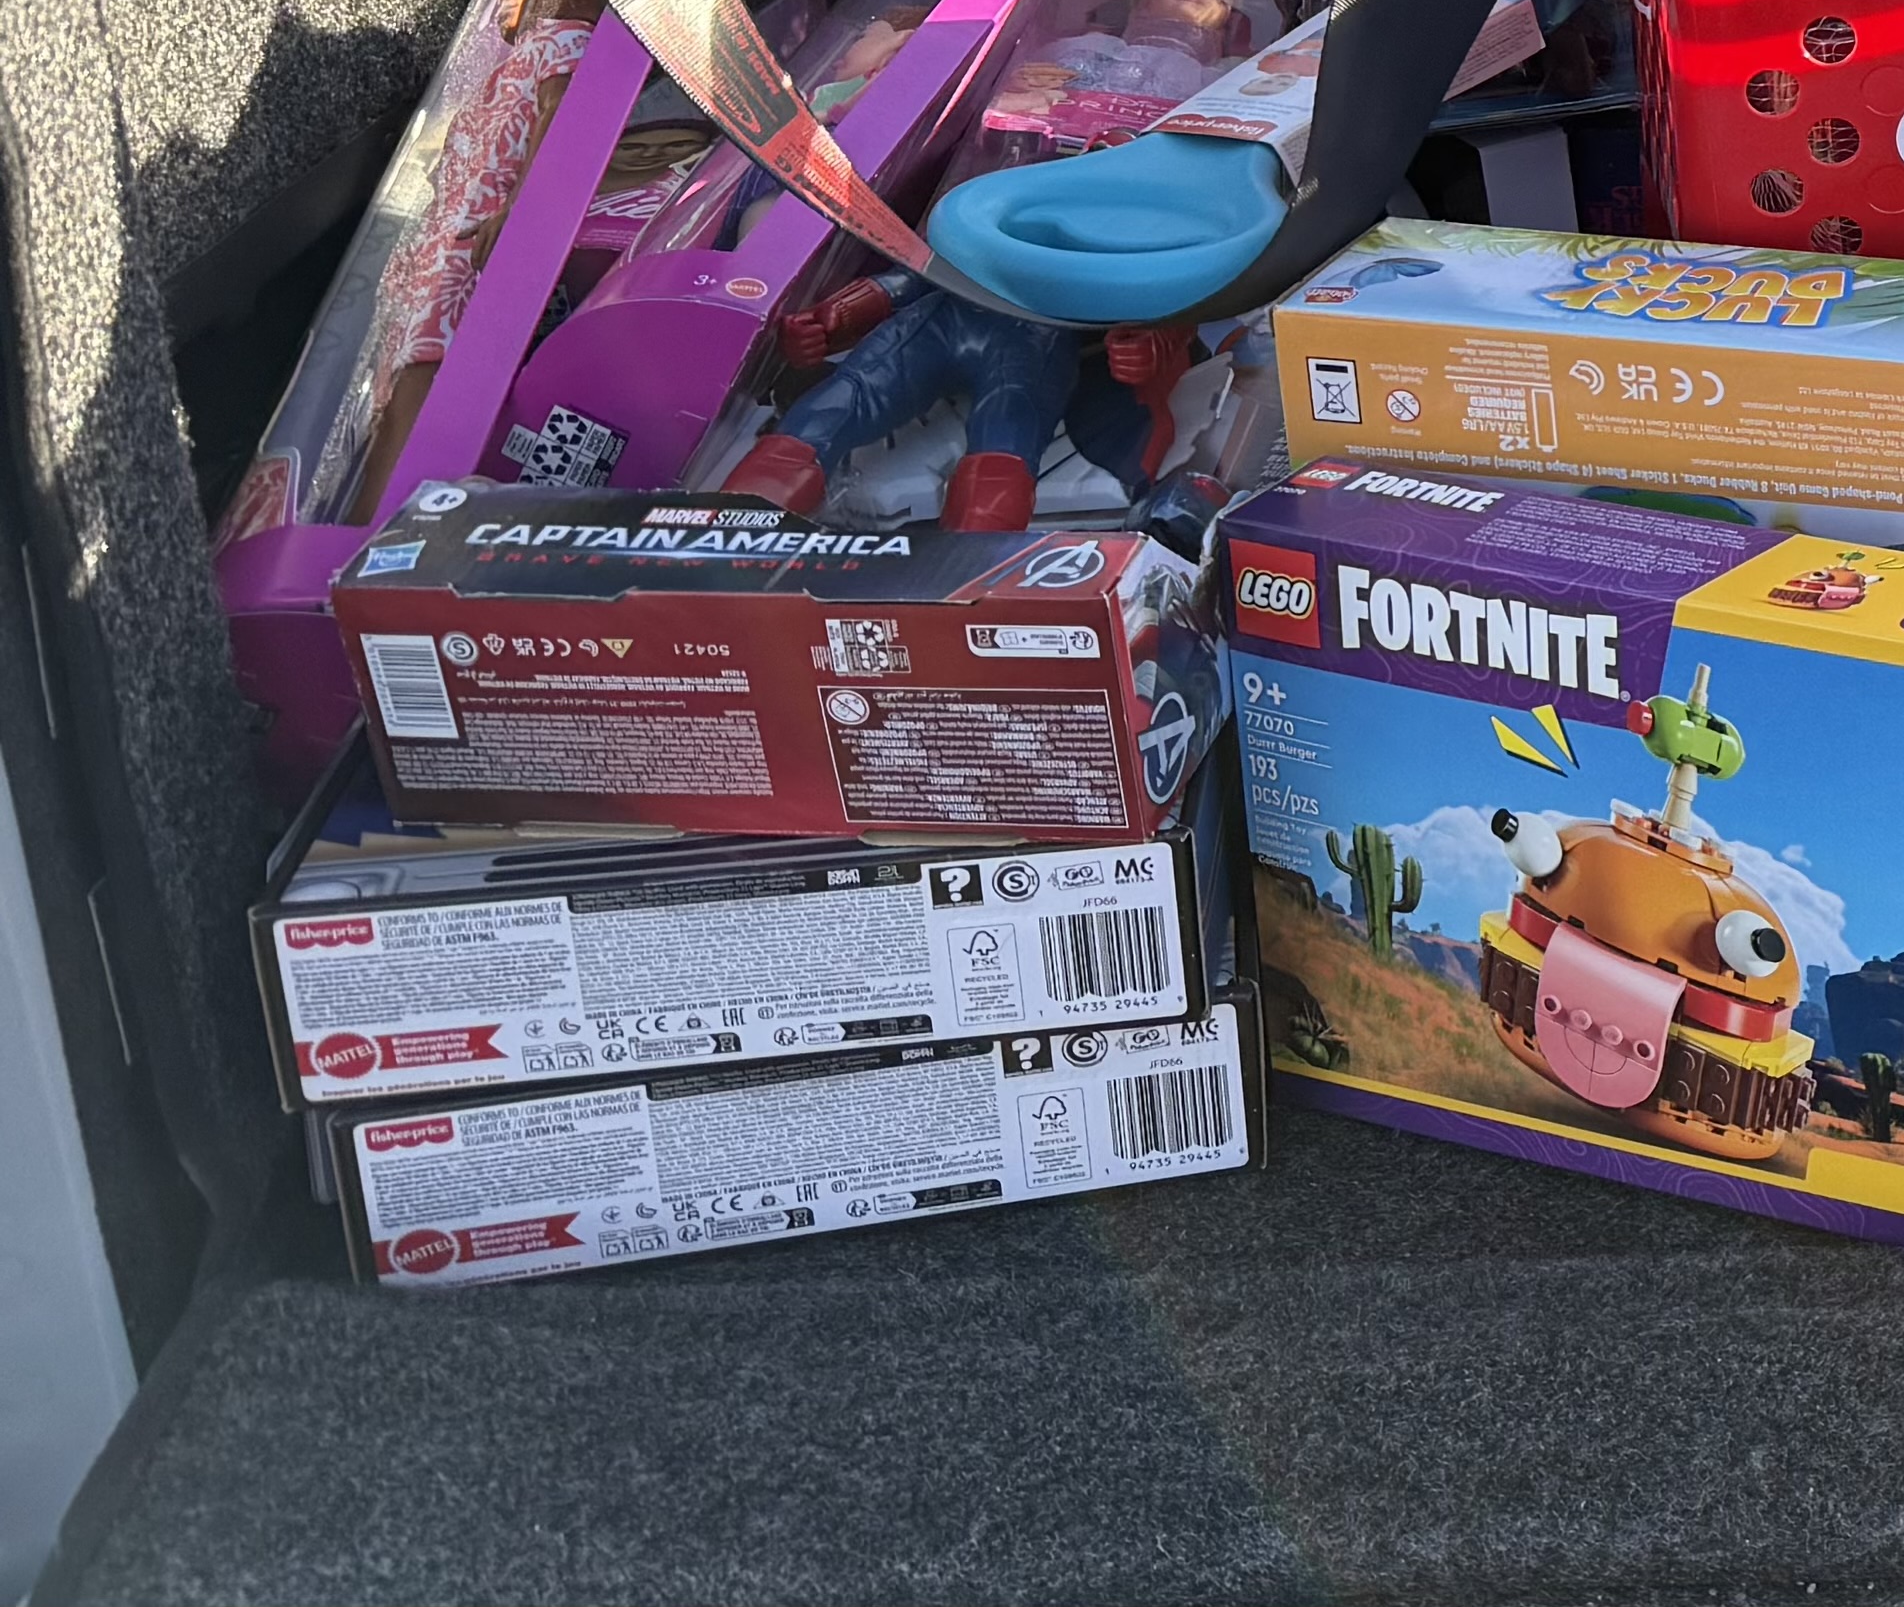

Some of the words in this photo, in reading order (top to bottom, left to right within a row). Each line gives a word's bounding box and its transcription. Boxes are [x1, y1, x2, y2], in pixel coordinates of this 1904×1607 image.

[1580, 251, 1848, 300] DUCKS
[1540, 282, 1829, 328] LUCKY
[1469, 396, 1527, 409] REQUIRED
[1466, 406, 1528, 422] BATTERIES
[1498, 435, 1531, 452] x2
[1416, 450, 1469, 466] Complete
[1470, 456, 1492, 467] and
[1493, 456, 1544, 473] Stickers)
[1546, 462, 1580, 477] Shape
[1594, 466, 1629, 481] Sheet
[1630, 469, 1670, 485] Sticker
[1302, 467, 1353, 483] LEGO
[1343, 470, 1505, 513] FORTNITE
[1721, 476, 1758, 492] Rubber
[1798, 483, 1829, 497] Game
[1831, 482, 1903, 504] Pond-shaped
[643, 508, 717, 526] MARVEL
[712, 509, 786, 527] STUDIOS
[465, 523, 684, 550] CAPTAIN
[680, 527, 912, 556] AMERICA
[475, 551, 603, 567] BRAVE
[730, 558, 862, 572] WORLD
[1238, 569, 1313, 619] LEGO
[1337, 564, 1622, 700] FORTNITE
[1241, 671, 1287, 707] 9+
[1243, 710, 1295, 736] 77070
[1278, 741, 1318, 761] Burger
[1248, 754, 1278, 781] 193
[1251, 784, 1320, 816] pcs/pzs
[1062, 999, 1109, 1014] 94735
[1115, 996, 1159, 1011] 29445
[317, 1042, 376, 1068] MATTEL
[395, 1050, 442, 1065] through
[1129, 1157, 1172, 1171] 94735
[1179, 1149, 1222, 1164] 29445
[398, 1241, 455, 1266] MATTEL
